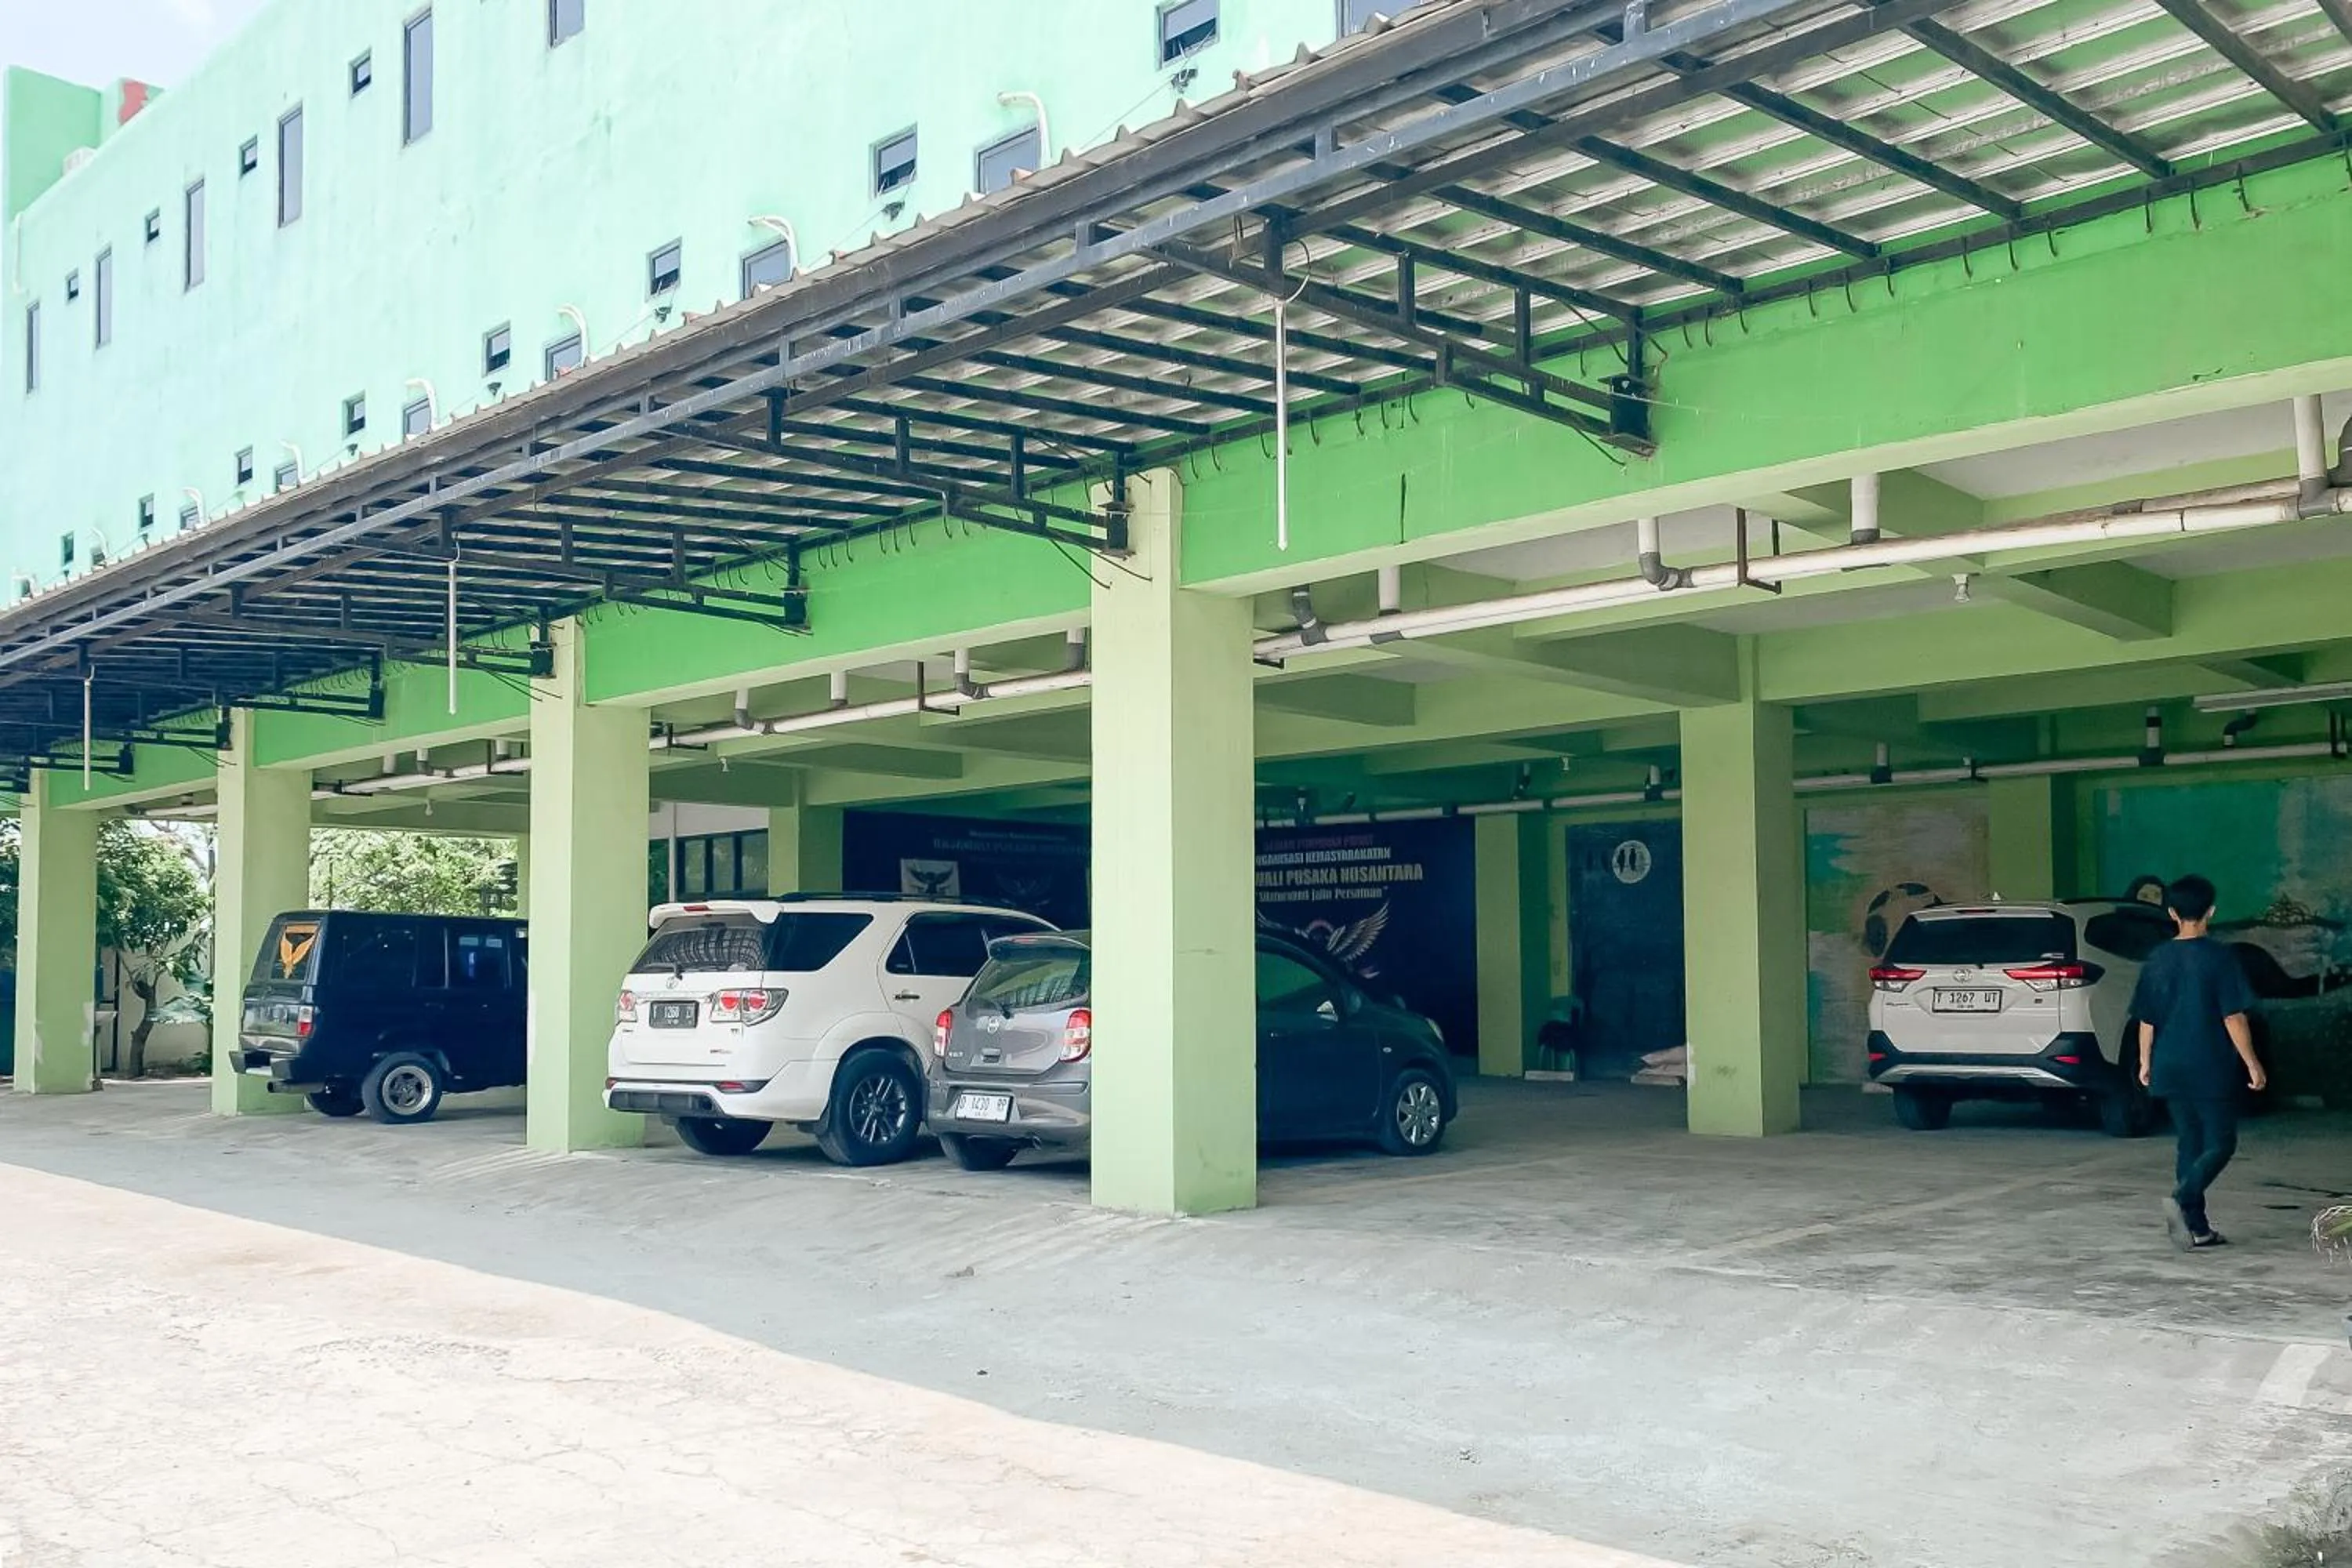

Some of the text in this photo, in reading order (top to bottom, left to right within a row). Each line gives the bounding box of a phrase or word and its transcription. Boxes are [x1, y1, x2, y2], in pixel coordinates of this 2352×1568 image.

[1287, 868, 1338, 886] PUSAKA
[1340, 863, 1423, 884] NUSANTARA
[1937, 992, 1998, 1004] T 1267 UT
